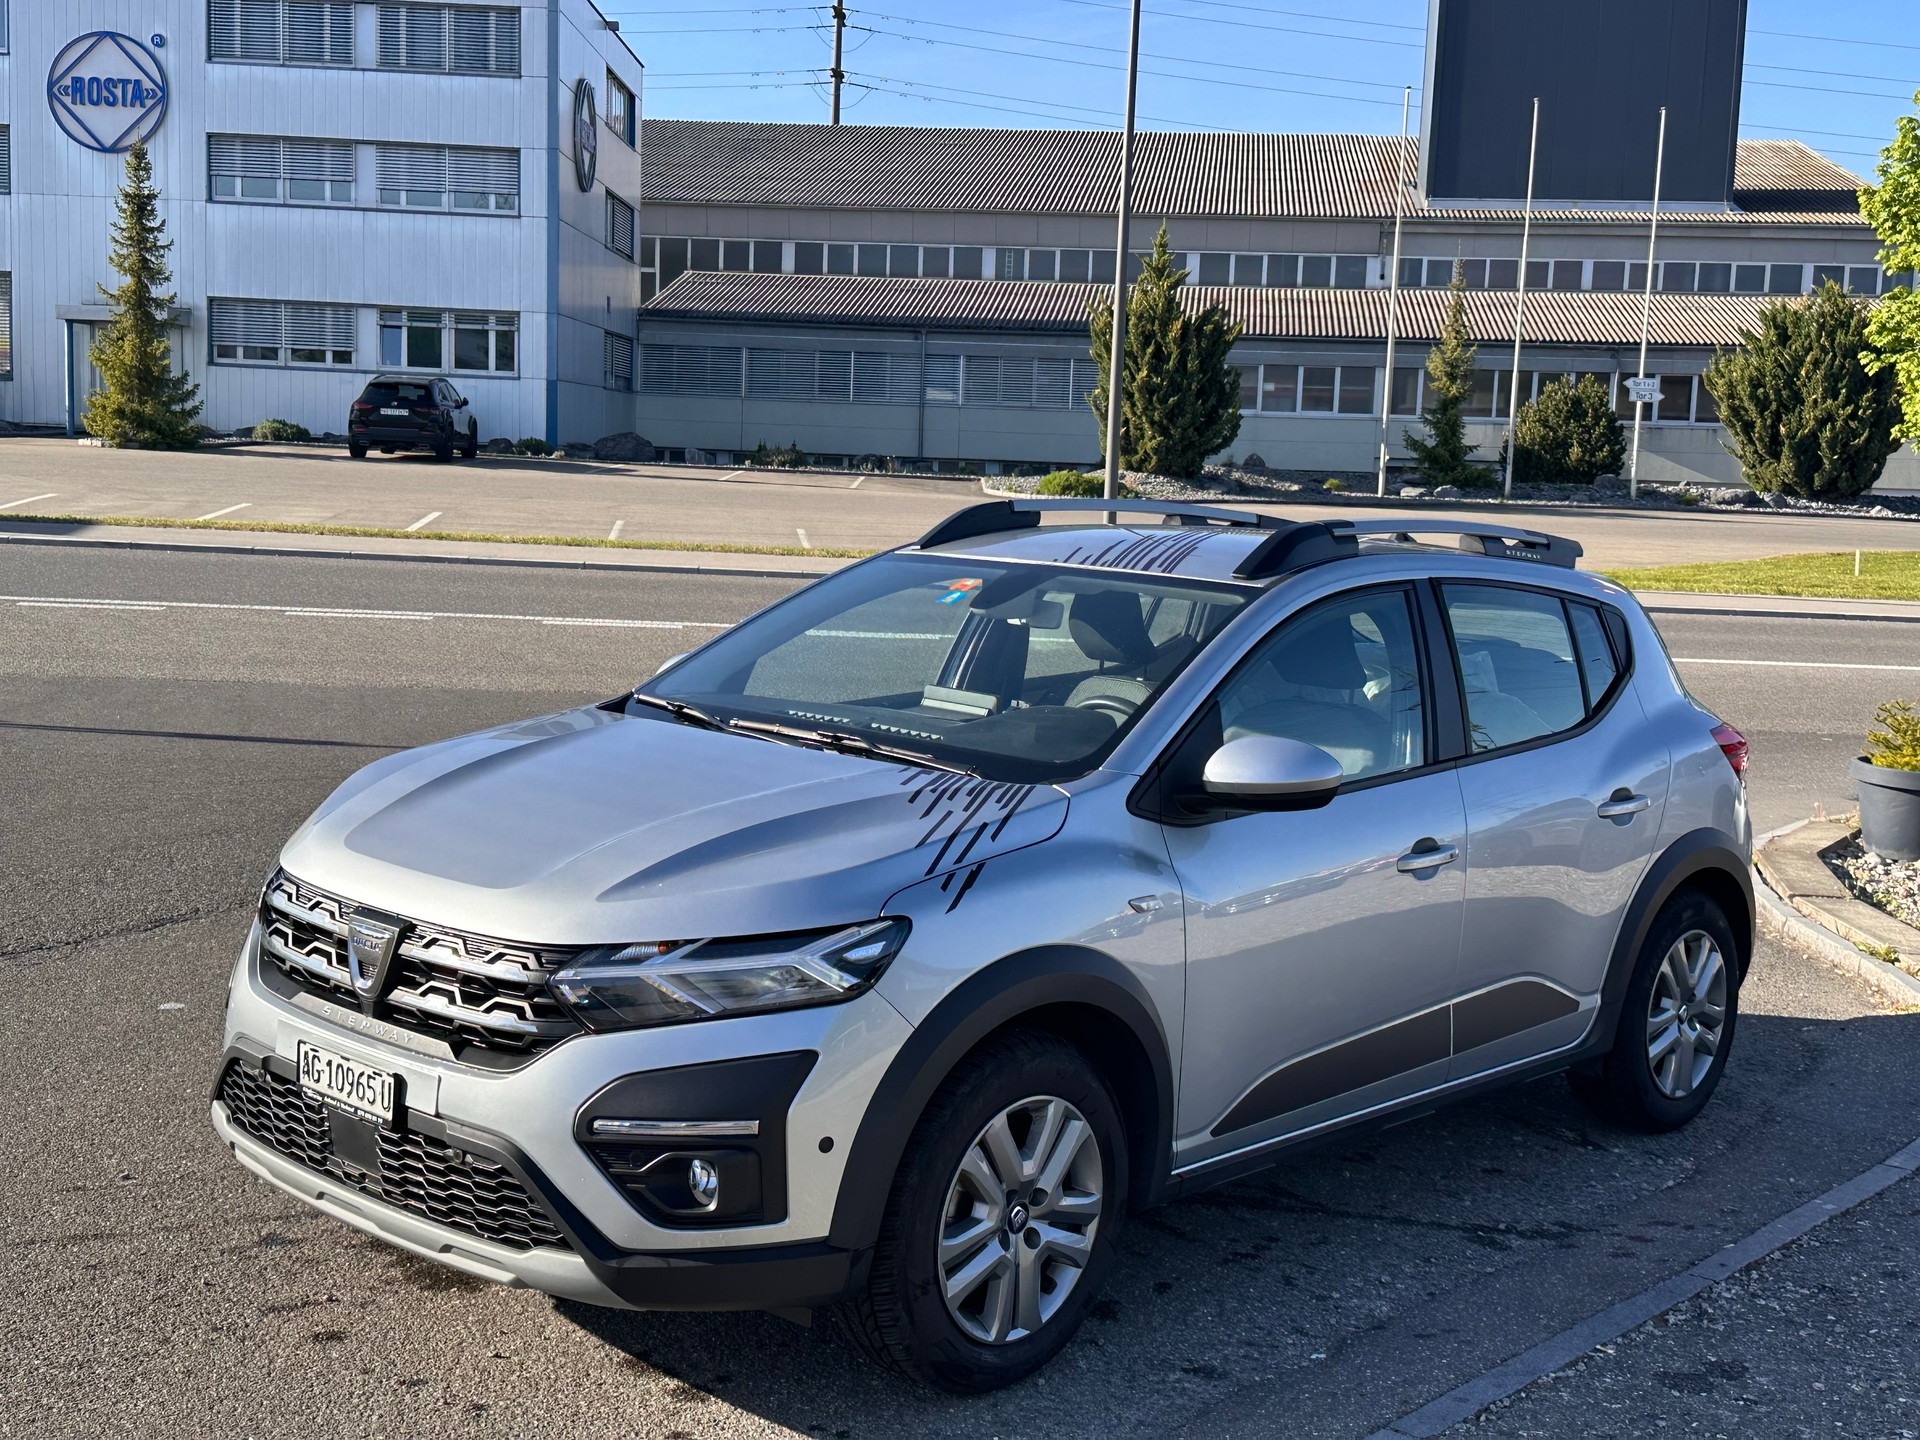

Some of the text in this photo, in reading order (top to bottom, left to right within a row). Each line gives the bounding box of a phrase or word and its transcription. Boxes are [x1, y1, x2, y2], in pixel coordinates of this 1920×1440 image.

[71, 76, 147, 108] ROSTA
[1635, 391, 1647, 400] Tor
[322, 1005, 414, 1044] STEPWAY
